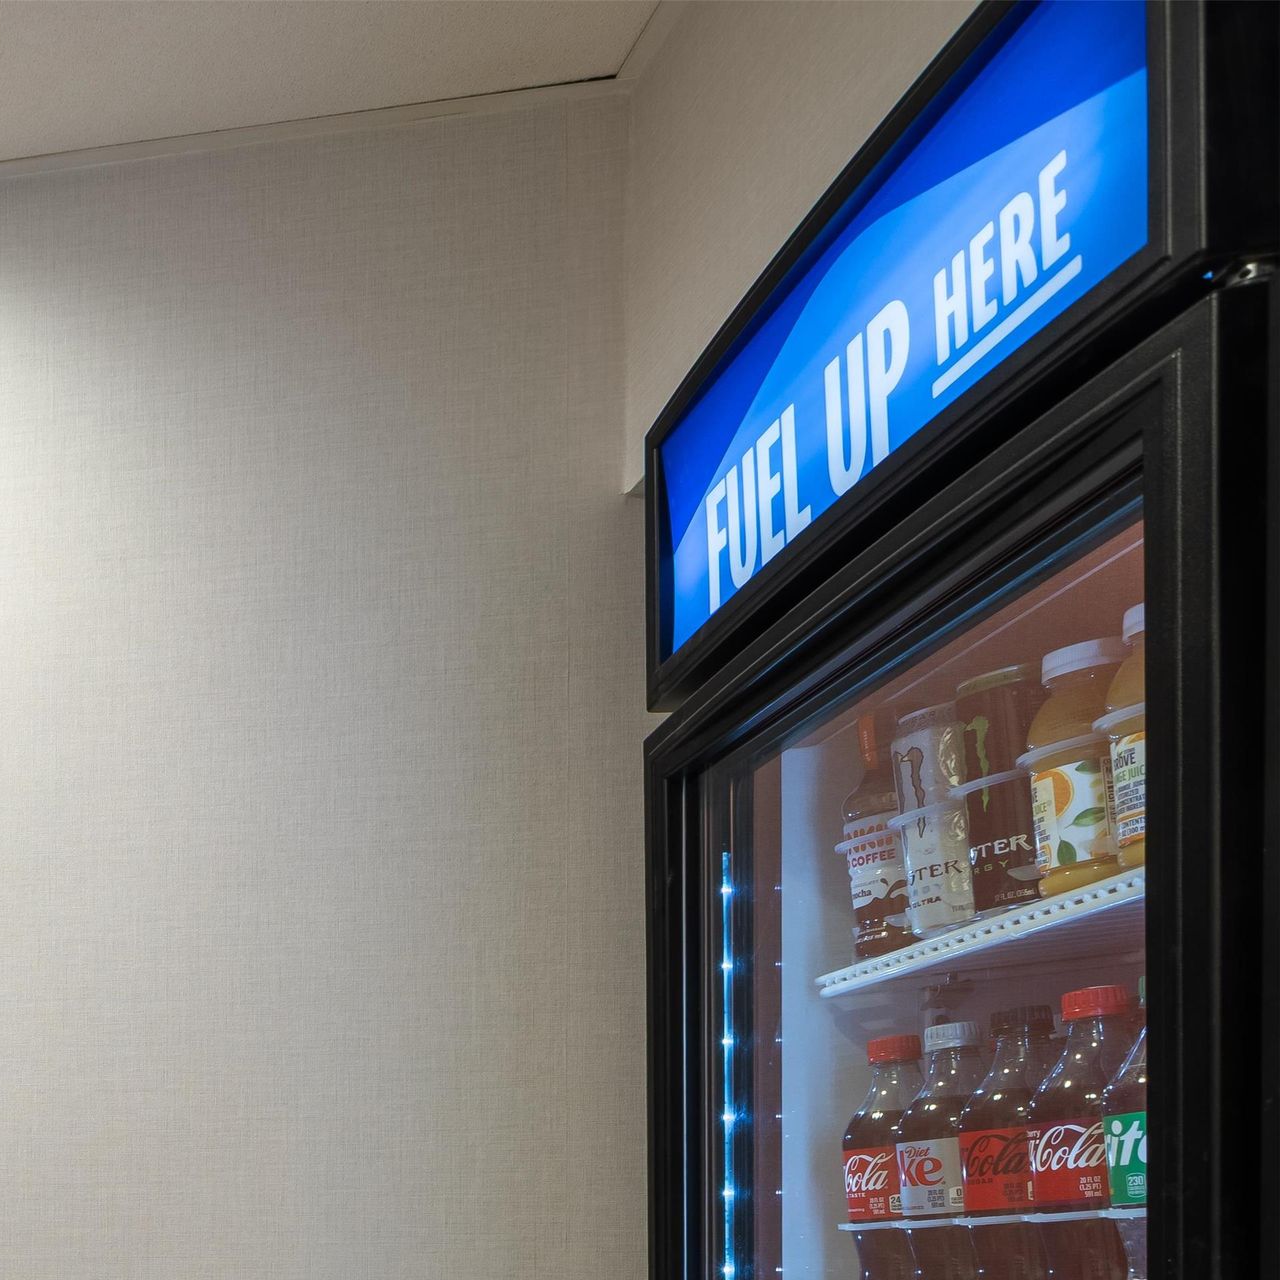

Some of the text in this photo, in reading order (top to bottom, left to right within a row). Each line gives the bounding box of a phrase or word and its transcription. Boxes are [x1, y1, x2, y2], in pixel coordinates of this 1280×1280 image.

[706, 150, 1077, 614] FUEL UP HERE
[851, 848, 896, 868] COFFEE
[905, 1146, 931, 1158] Diet
[1036, 1122, 1105, 1172] Cola
